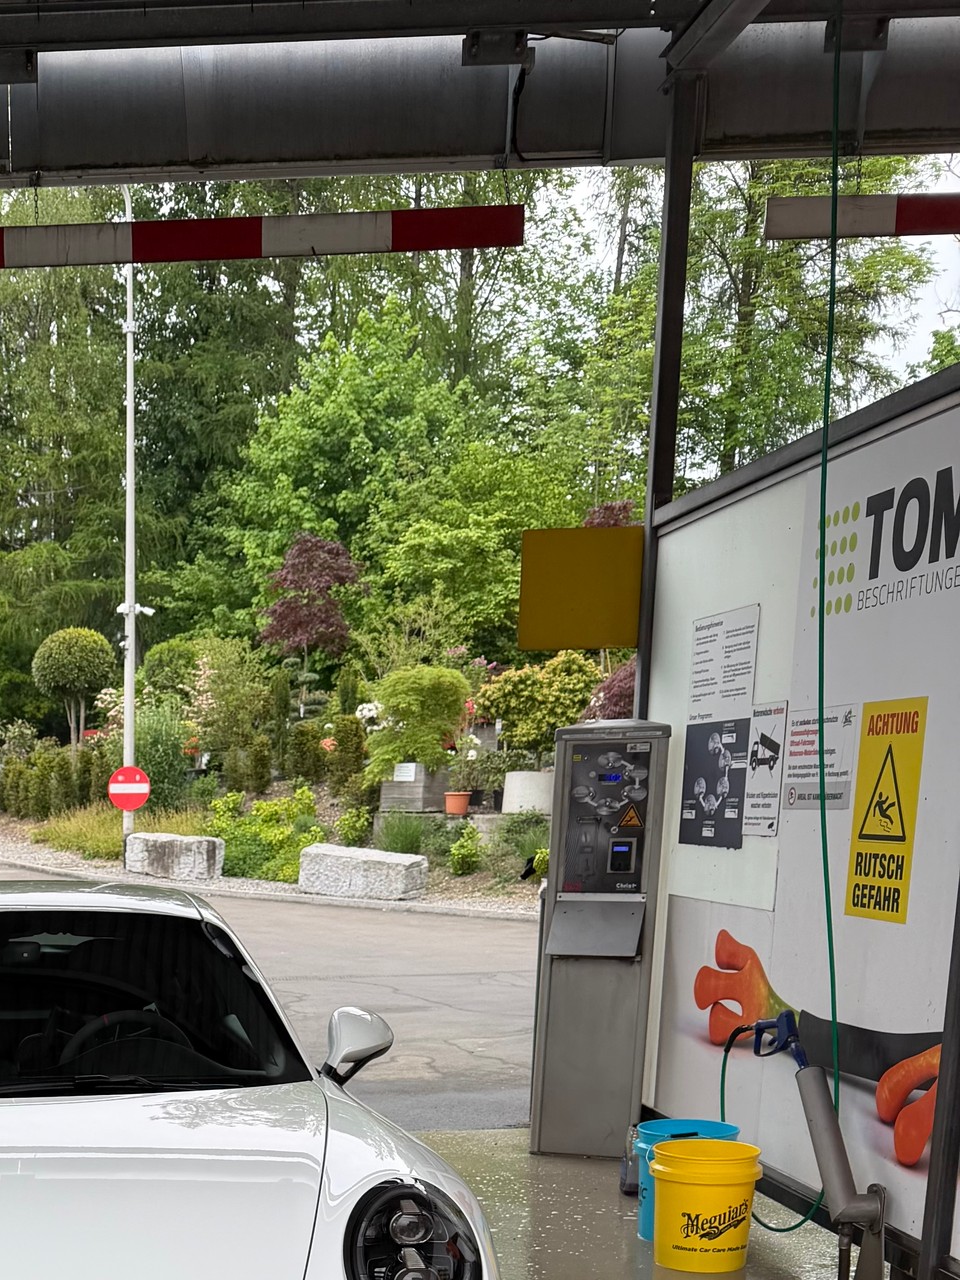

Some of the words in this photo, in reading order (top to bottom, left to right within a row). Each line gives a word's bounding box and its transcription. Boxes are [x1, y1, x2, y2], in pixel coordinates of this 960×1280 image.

[867, 710, 919, 737] ACHTUNG
[855, 851, 905, 881] RUTSCH
[852, 882, 901, 914] GEFAHR
[680, 1198, 749, 1239] Meguiar's
[671, 1244, 698, 1253] Ultimate
